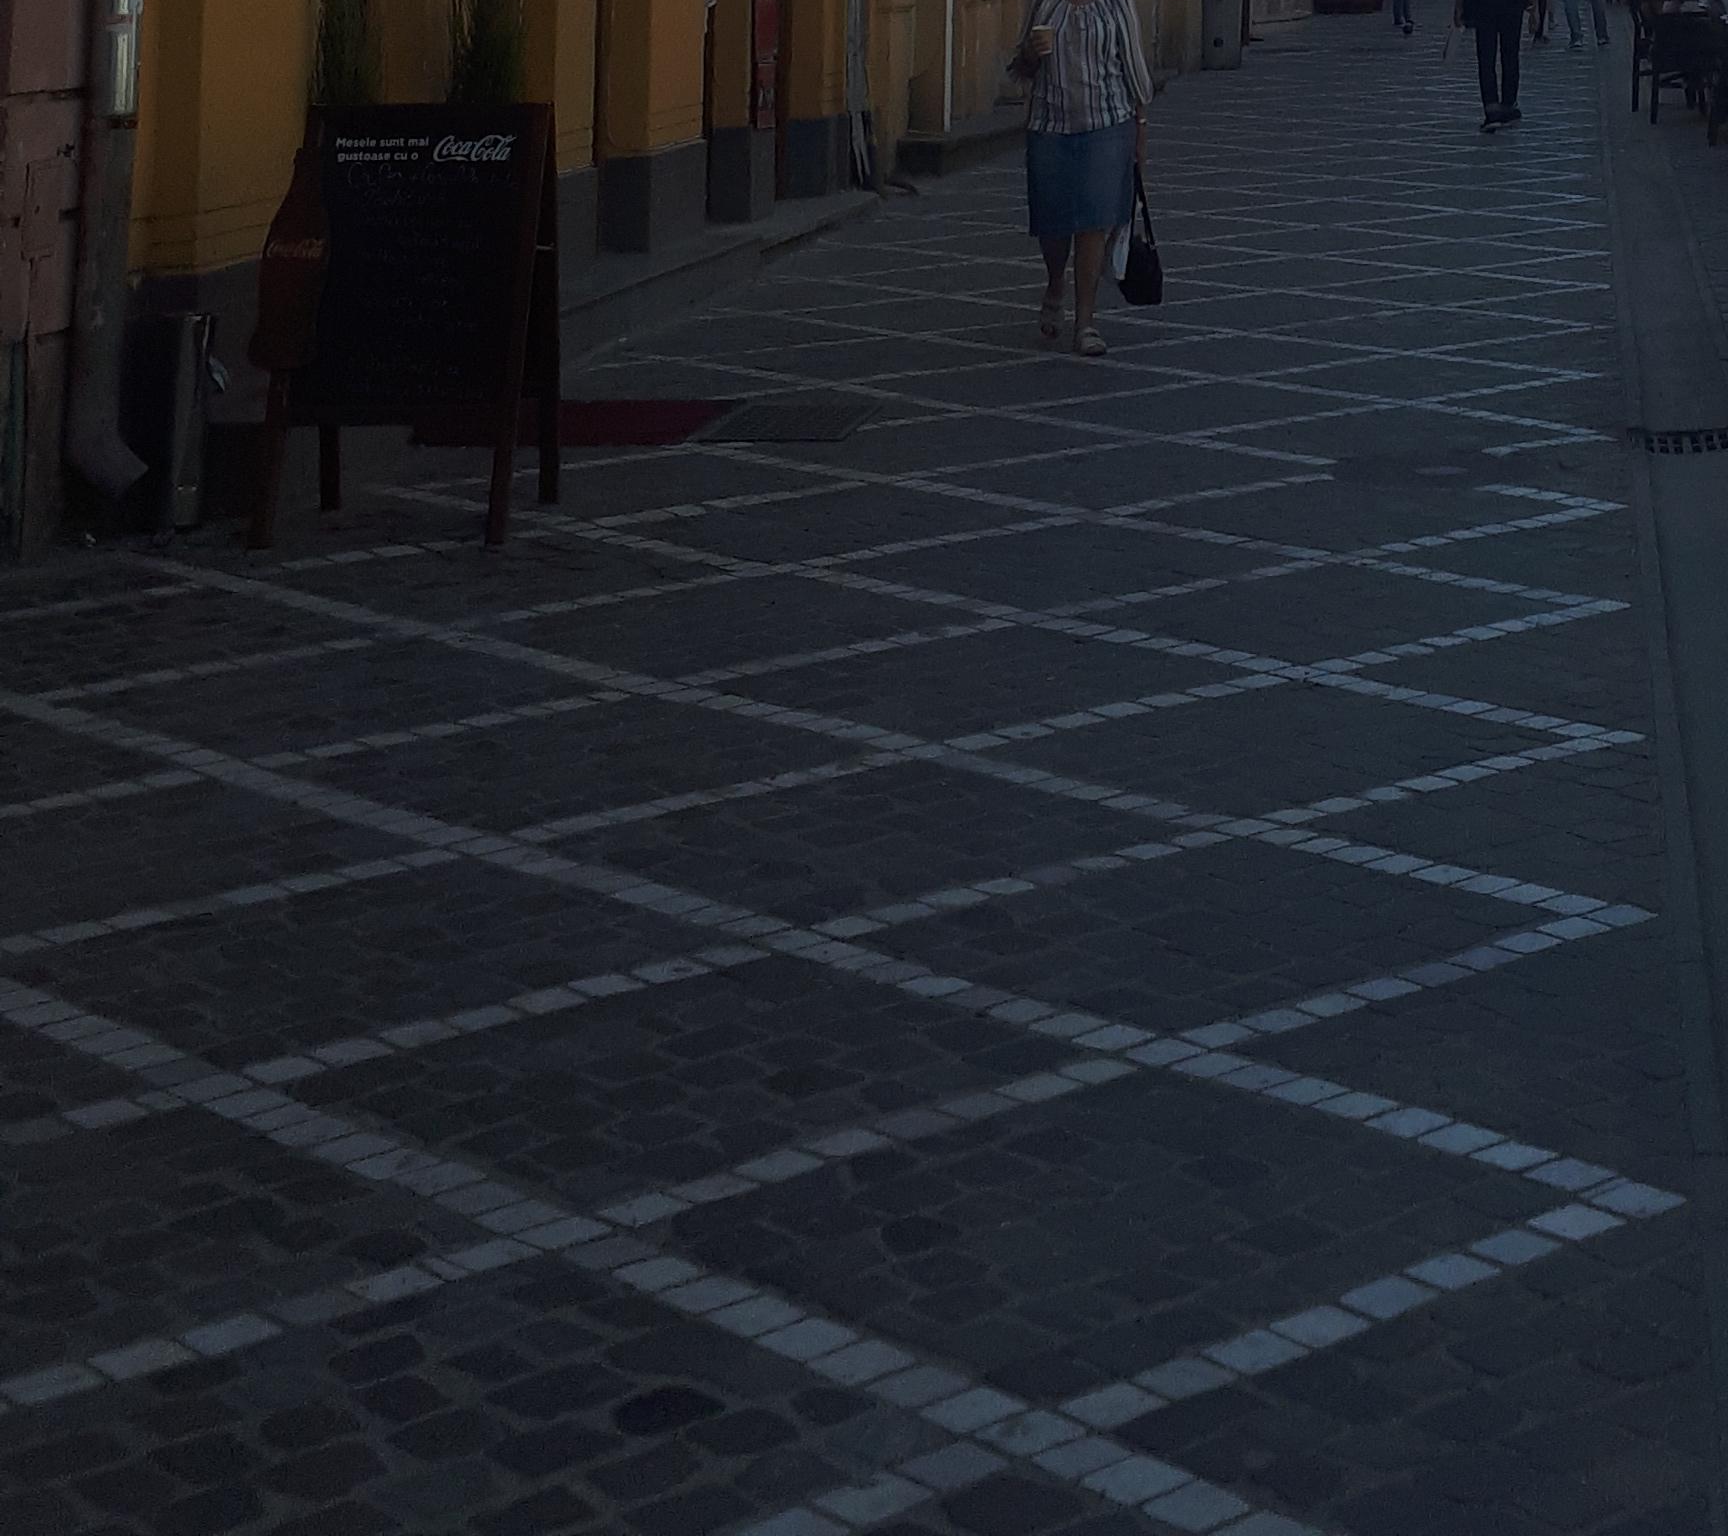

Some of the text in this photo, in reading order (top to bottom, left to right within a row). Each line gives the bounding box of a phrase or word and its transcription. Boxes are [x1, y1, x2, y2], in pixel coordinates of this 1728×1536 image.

[336, 137, 377, 148] Mesele
[379, 137, 404, 148] sunt
[336, 152, 419, 164] gustoase cu o
